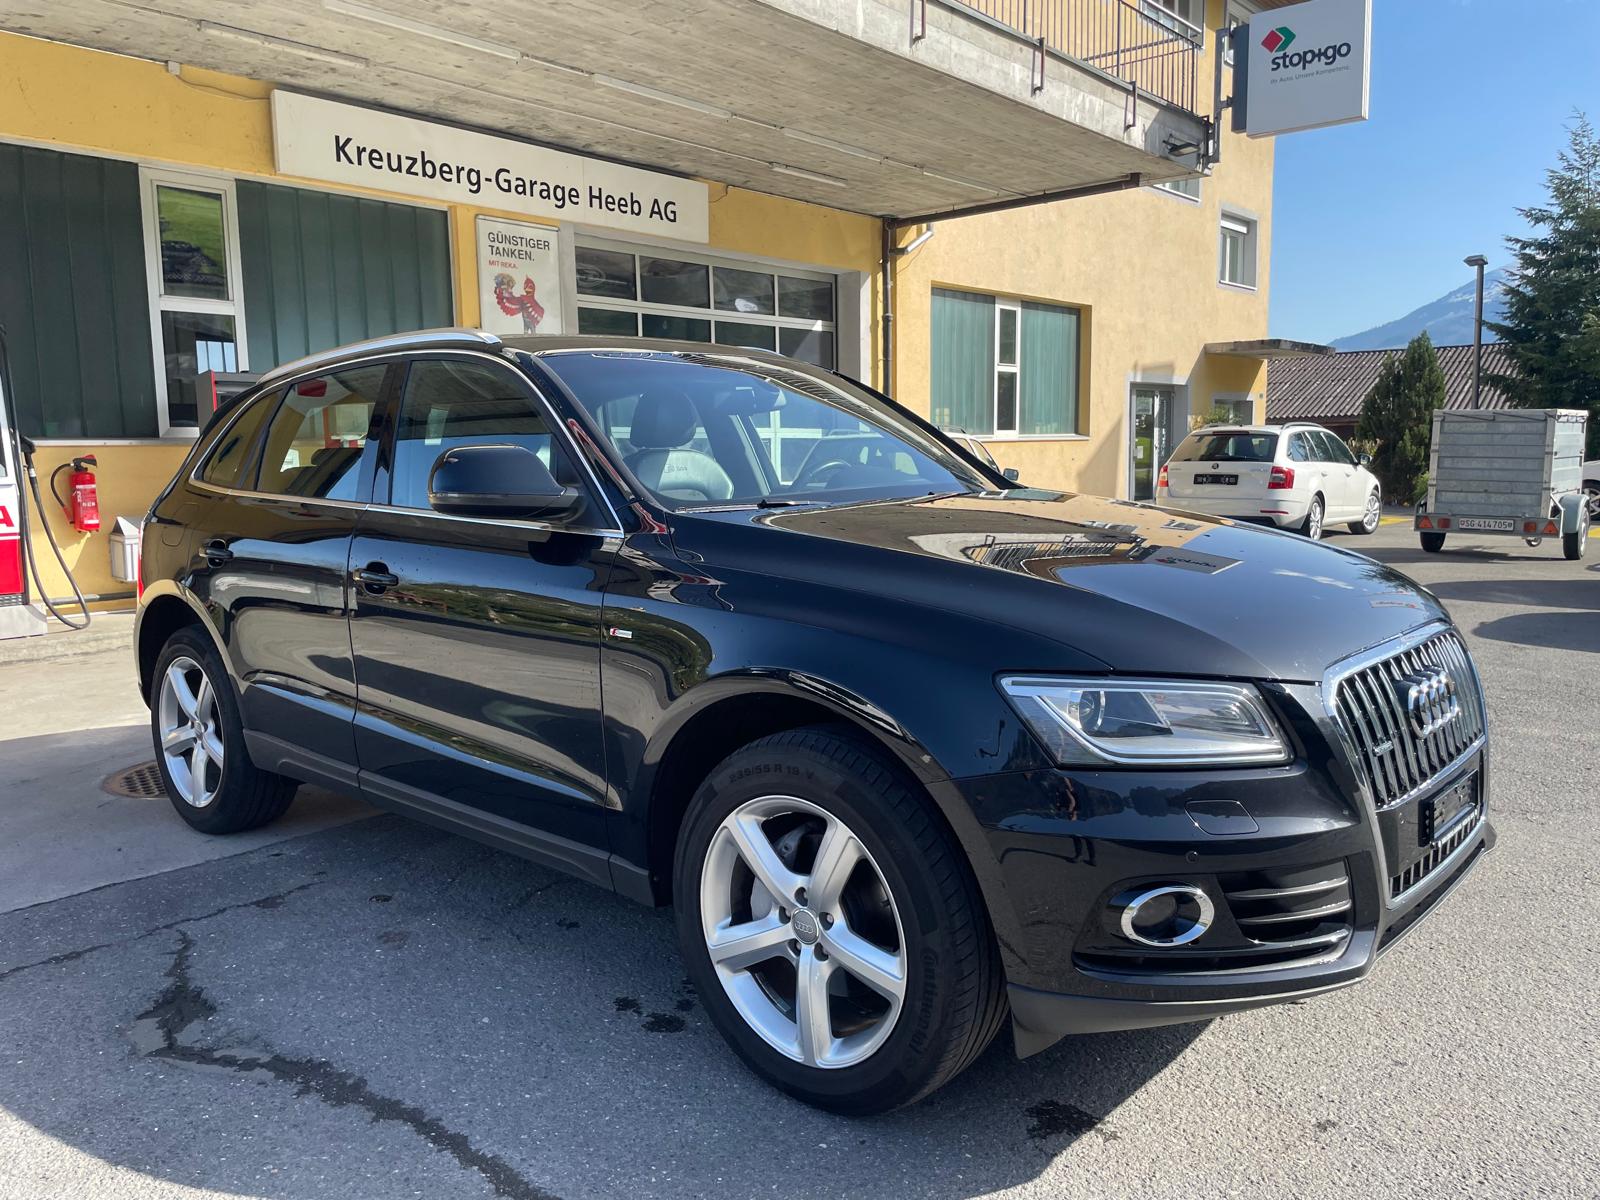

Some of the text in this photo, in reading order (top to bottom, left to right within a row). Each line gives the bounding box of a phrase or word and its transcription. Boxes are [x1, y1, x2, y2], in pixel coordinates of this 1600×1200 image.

[1271, 42, 1351, 72] stop+go
[334, 135, 678, 223] Kreuzberg-Garage Heeb AG
[487, 231, 550, 251] GÜNSTIGER
[488, 245, 535, 261] TANKEN.
